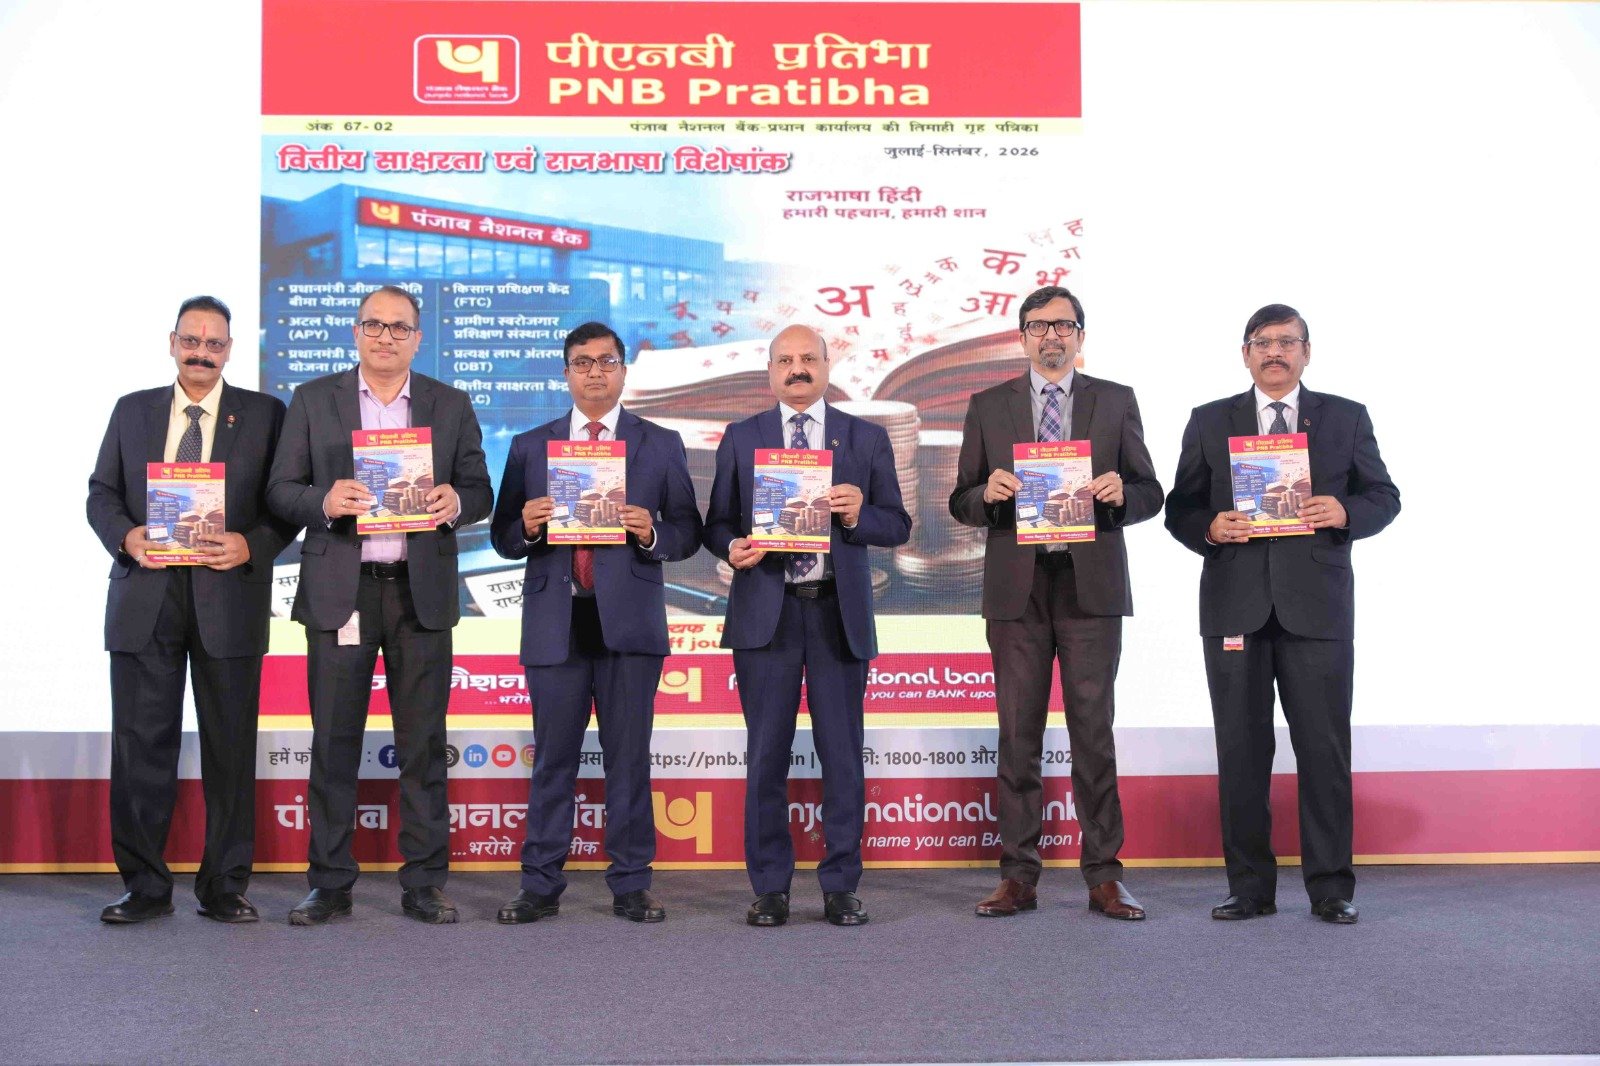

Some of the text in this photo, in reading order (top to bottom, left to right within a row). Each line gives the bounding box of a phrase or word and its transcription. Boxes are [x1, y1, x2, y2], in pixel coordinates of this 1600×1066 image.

[545, 32, 932, 71] पीएनबी प्रतिभा
[549, 77, 930, 106] PNB Pratibha
[306, 120, 334, 132] अंक
[630, 121, 668, 132] पंजाब
[678, 120, 725, 132] नैशनल
[815, 121, 872, 132] कार्यालय
[882, 121, 900, 132] की
[909, 121, 955, 132] तिमाही
[995, 121, 1039, 133] पत्रिका
[277, 143, 791, 173] वित्तीय साक्षरता एवं राजभाषा विशेषांक
[999, 147, 1039, 156] 2026
[785, 186, 922, 204] राजभाषा हिंदी
[782, 205, 828, 220] हमारी
[902, 205, 947, 219] हमारी
[953, 208, 987, 219] शान
[411, 208, 583, 246] पंजाब नैशनल बैंक
[983, 248, 1027, 275] क
[453, 282, 493, 294] किसान
[497, 281, 544, 294] प्रशिक्षण
[289, 295, 361, 306] बीमा योजना
[454, 297, 492, 308] (FTC)
[815, 285, 874, 317] अ
[289, 316, 321, 327] अटल
[454, 314, 559, 326] ग्रामीण स्वरोजगार
[289, 329, 329, 341] (APY)
[453, 327, 503, 340] प्रशिक्षण
[493, 349, 520, 359] लाभ
[289, 361, 329, 372] योजना
[453, 361, 493, 373] (DBT)
[496, 380, 544, 391] साक्षरता
[451, 666, 525, 692] नैशन
[944, 667, 995, 684] ban
[871, 689, 996, 700] you can BANK upo
[269, 748, 290, 765] हमें
[884, 751, 966, 765] 1800-1800
[971, 745, 997, 765] और
[864, 793, 998, 823] national
[867, 836, 911, 847] name
[914, 836, 944, 850] you
[948, 835, 976, 847] can
[982, 832, 1003, 847] BA
